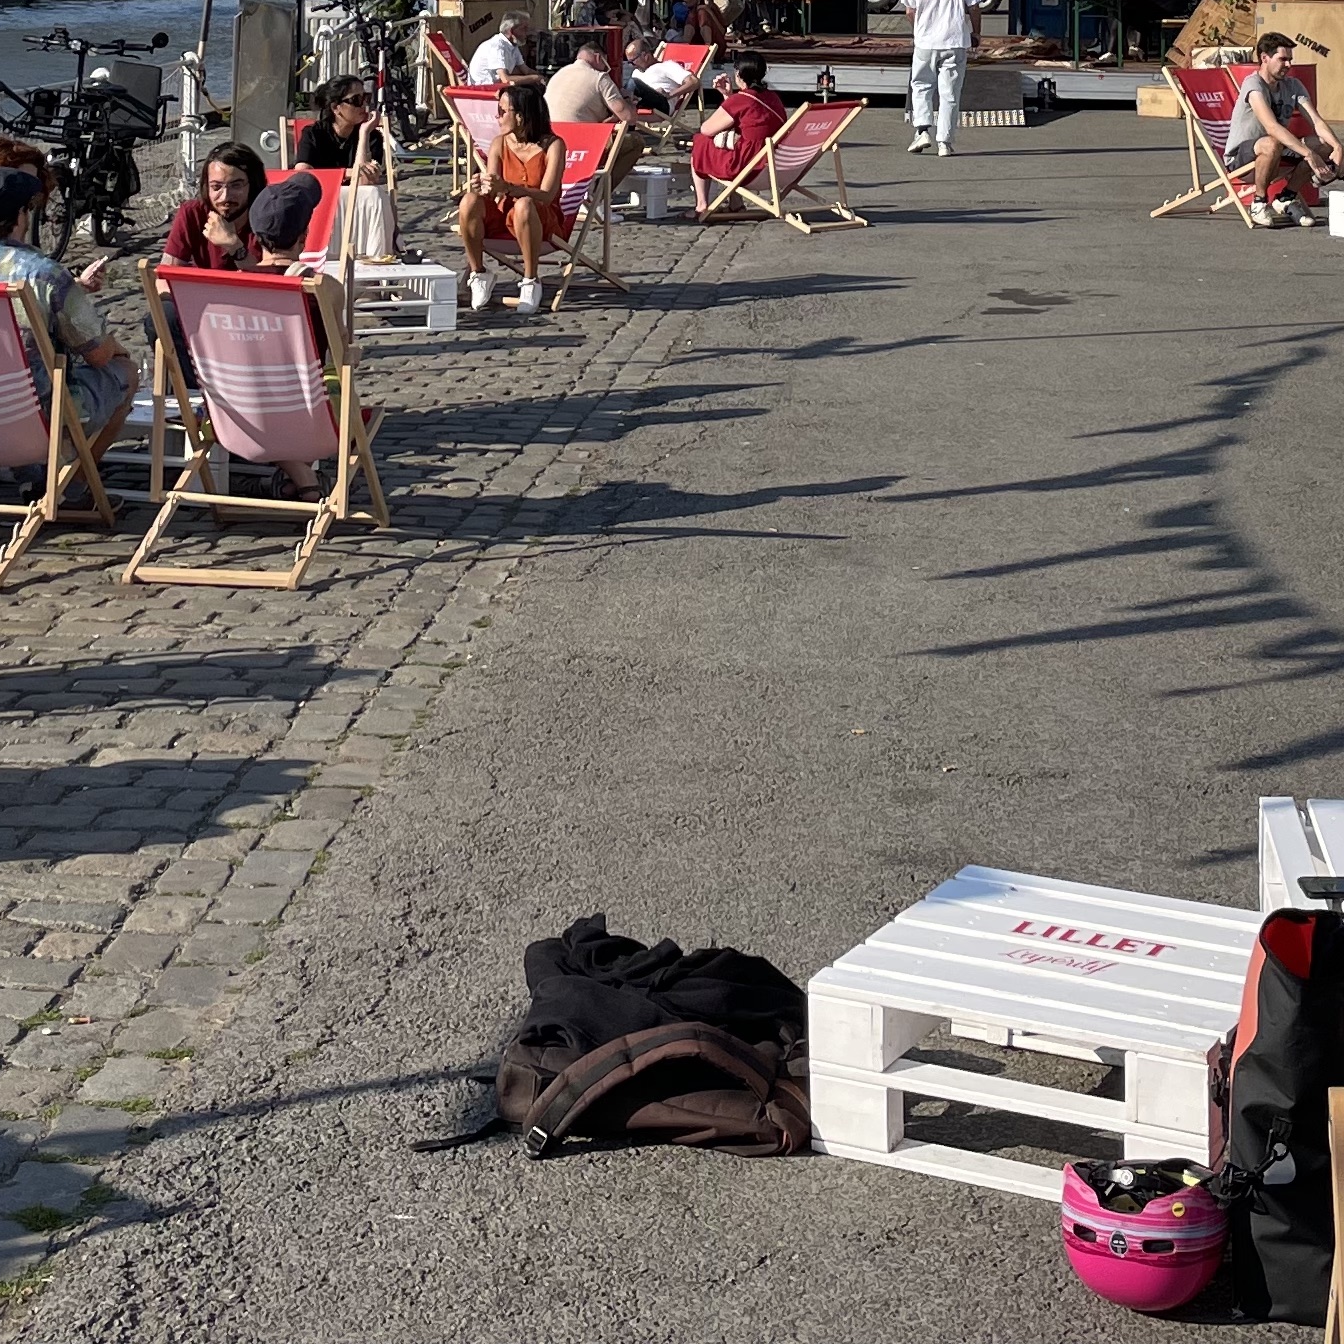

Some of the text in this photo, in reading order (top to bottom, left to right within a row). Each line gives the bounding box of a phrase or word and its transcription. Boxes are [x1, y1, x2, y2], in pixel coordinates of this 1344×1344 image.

[1194, 91, 1225, 103] LILLET
[566, 150, 588, 161] LET
[1011, 920, 1177, 957] LILLET
